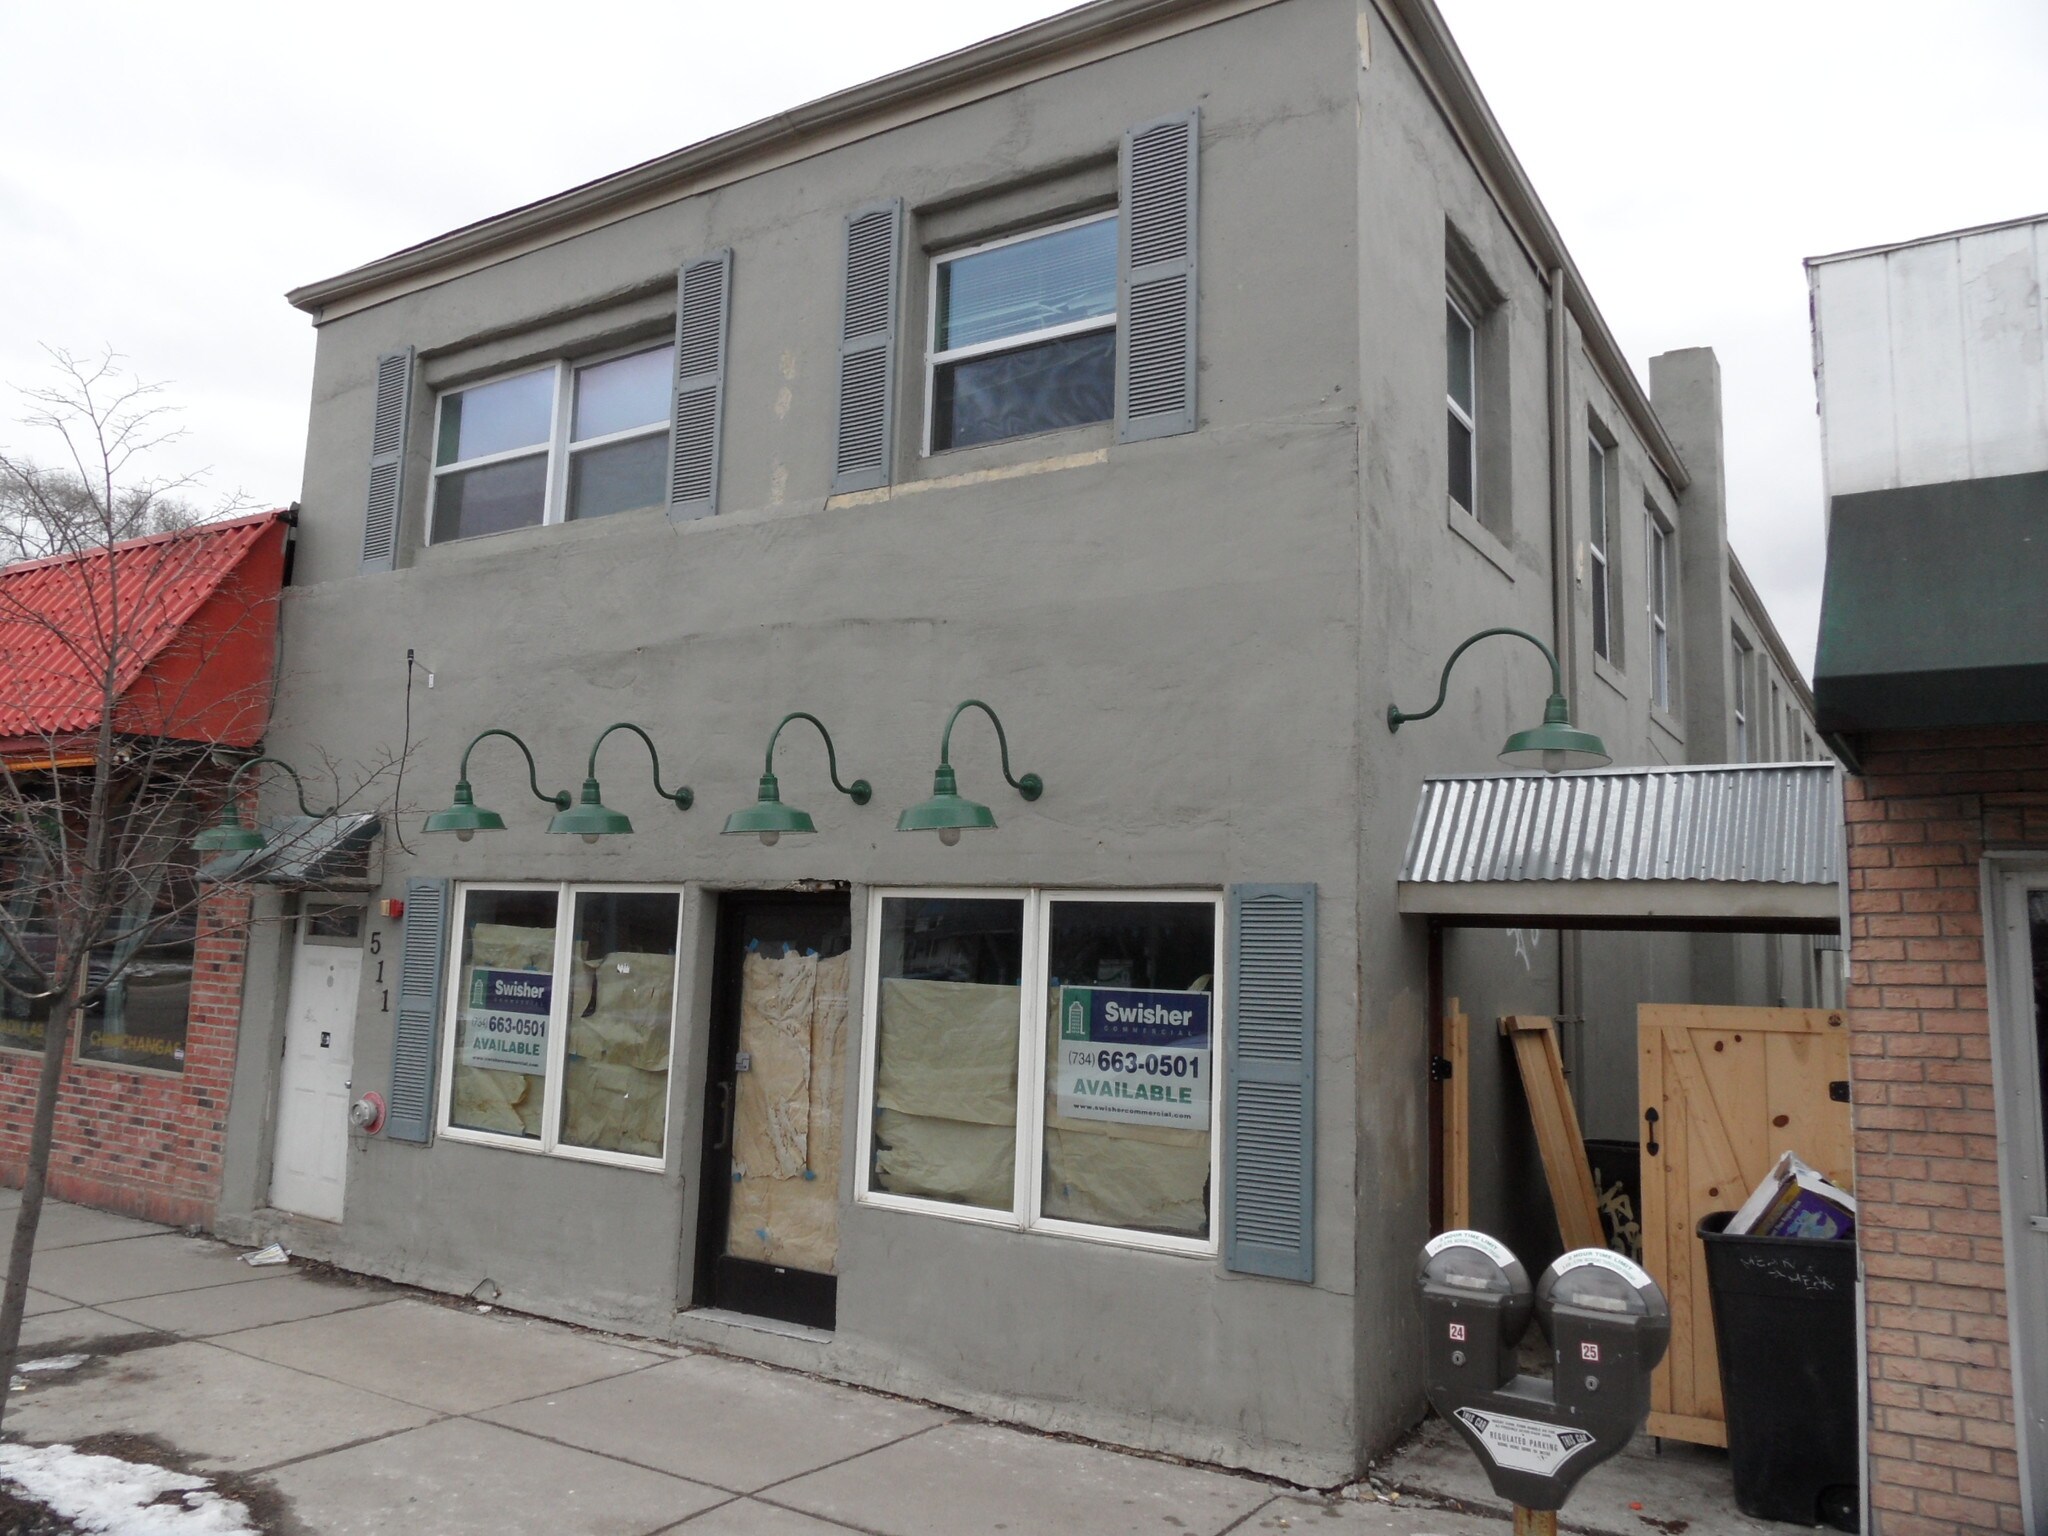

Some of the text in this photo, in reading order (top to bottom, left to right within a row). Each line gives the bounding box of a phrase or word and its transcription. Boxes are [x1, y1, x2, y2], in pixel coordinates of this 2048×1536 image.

[495, 979, 545, 999] Swisher
[1105, 1001, 1193, 1026] Swisher
[489, 1015, 546, 1038] 663-0501
[1103, 1025, 1192, 1037] COMMERCIAL
[473, 1036, 540, 1056] AVAILABLE
[1068, 1050, 1199, 1078] (734) 663-0501
[1073, 1078, 1192, 1105] AVAILABLE
[1073, 1103, 1192, 1120] www.swishercommercial.com
[1451, 1325, 1464, 1339] 24
[1583, 1344, 1597, 1359] 25
[1489, 1431, 1526, 1446] REGULATED
[1529, 1439, 1559, 1452] PARKING
